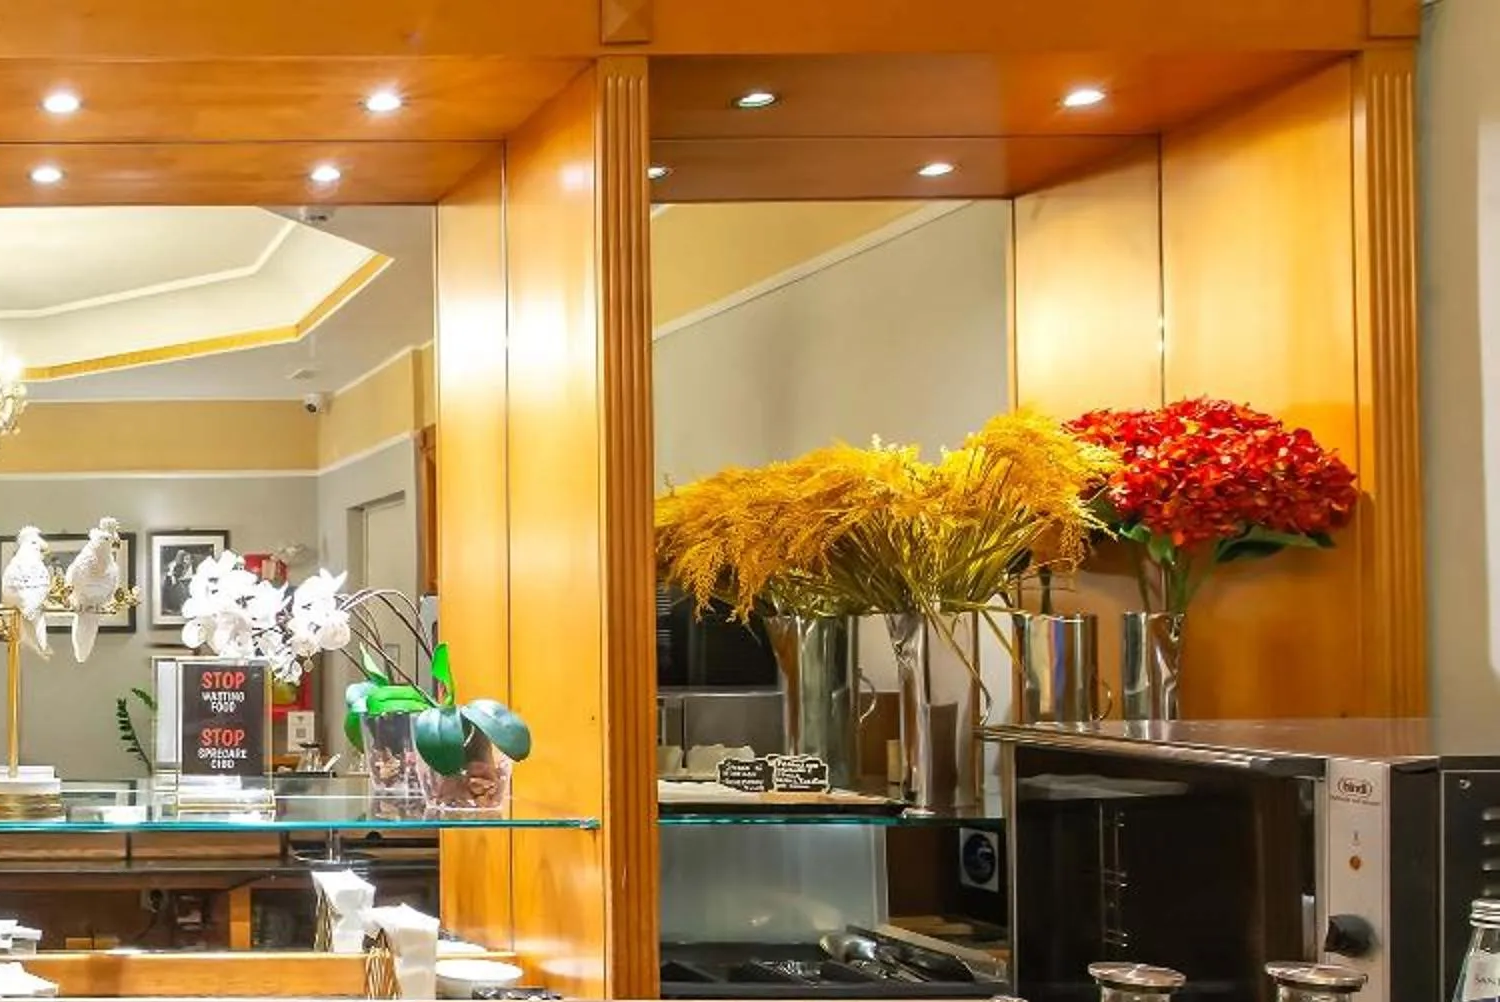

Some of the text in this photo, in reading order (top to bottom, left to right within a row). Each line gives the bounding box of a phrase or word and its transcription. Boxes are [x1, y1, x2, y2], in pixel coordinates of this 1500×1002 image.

[202, 672, 245, 689] STOP
[202, 691, 245, 702] WASTING
[211, 702, 236, 713] FOOD
[202, 729, 245, 746] STOP
[198, 748, 247, 759] SPRECARE
[211, 759, 235, 769] CIBO
